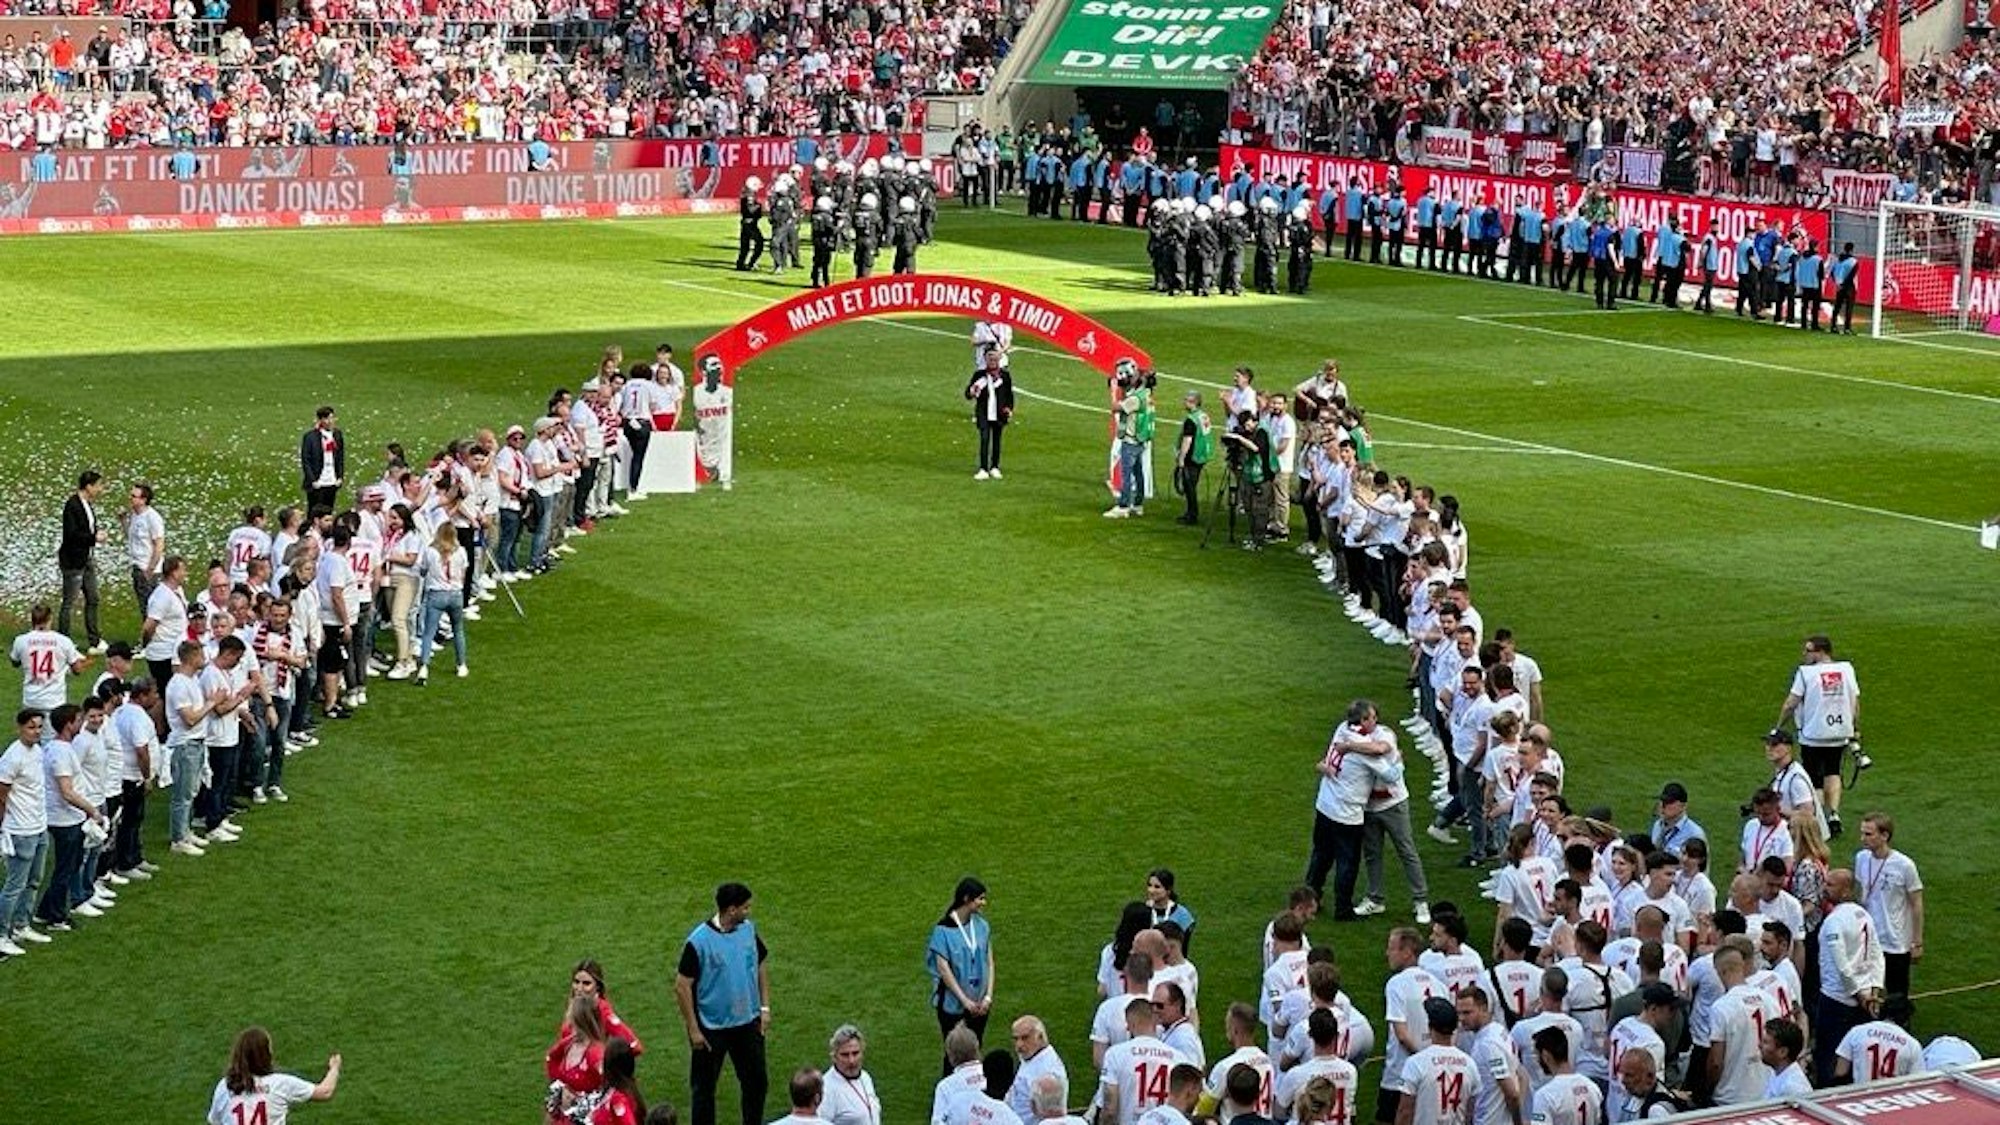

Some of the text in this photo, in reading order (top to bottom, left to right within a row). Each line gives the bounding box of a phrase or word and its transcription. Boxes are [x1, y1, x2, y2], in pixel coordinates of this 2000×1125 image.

[1081, 1, 1270, 20] stonn zo
[1111, 25, 1225, 45] Dir!
[1061, 50, 1240, 69] DEVK
[1260, 153, 1375, 195] DANKE JONAS!
[180, 180, 365, 214] DANKE JONAS!
[506, 173, 661, 206] DANKE TIMO!
[1429, 173, 1547, 216] DANKE TIMO!
[1619, 196, 1671, 232] MAAT
[1679, 202, 1703, 236] ET
[786, 281, 1064, 337] MAAT ET JOOT, JONAS & TIMO!
[631, 390, 639, 409] 1
[234, 543, 255, 566] 14
[350, 552, 369, 577] 14
[30, 650, 55, 679] 14
[1826, 714, 1843, 727] 04
[1513, 988, 1525, 1015] 1
[1866, 1028, 1907, 1047] CAPITANO
[1131, 1046, 1174, 1060] CAPITANO
[1867, 1043, 1898, 1079] 14
[1135, 1062, 1168, 1108] 14
[1437, 1070, 1464, 1114] 14
[1577, 1101, 1587, 1125] 1
[1836, 1088, 1957, 1116] REWE
